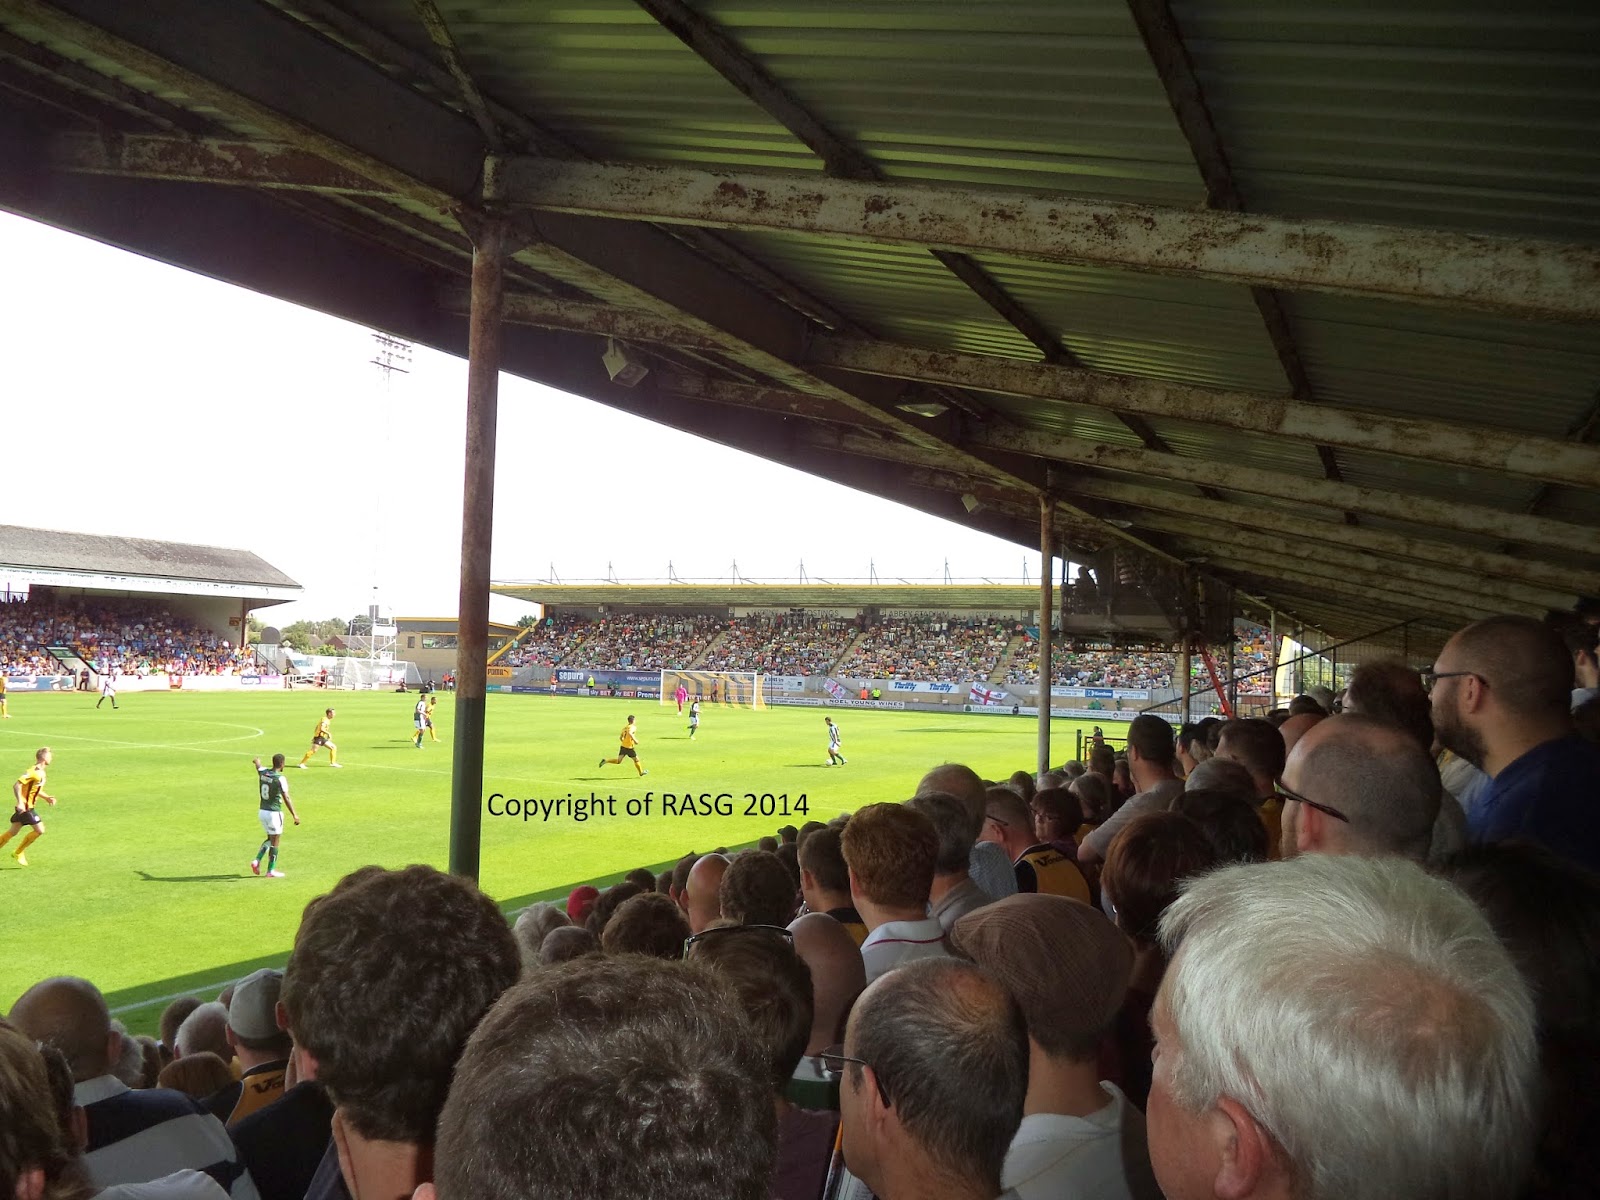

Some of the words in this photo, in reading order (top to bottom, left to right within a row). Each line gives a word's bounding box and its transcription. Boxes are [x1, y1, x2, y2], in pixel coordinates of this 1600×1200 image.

[487, 668, 504, 676] PUMA
[559, 671, 584, 681] sepura
[894, 682, 917, 691] Thrifty
[929, 683, 953, 692] Thrifty
[600, 689, 611, 697] BET
[637, 690, 661, 699] Preme
[972, 704, 1010, 713] Inheritance
